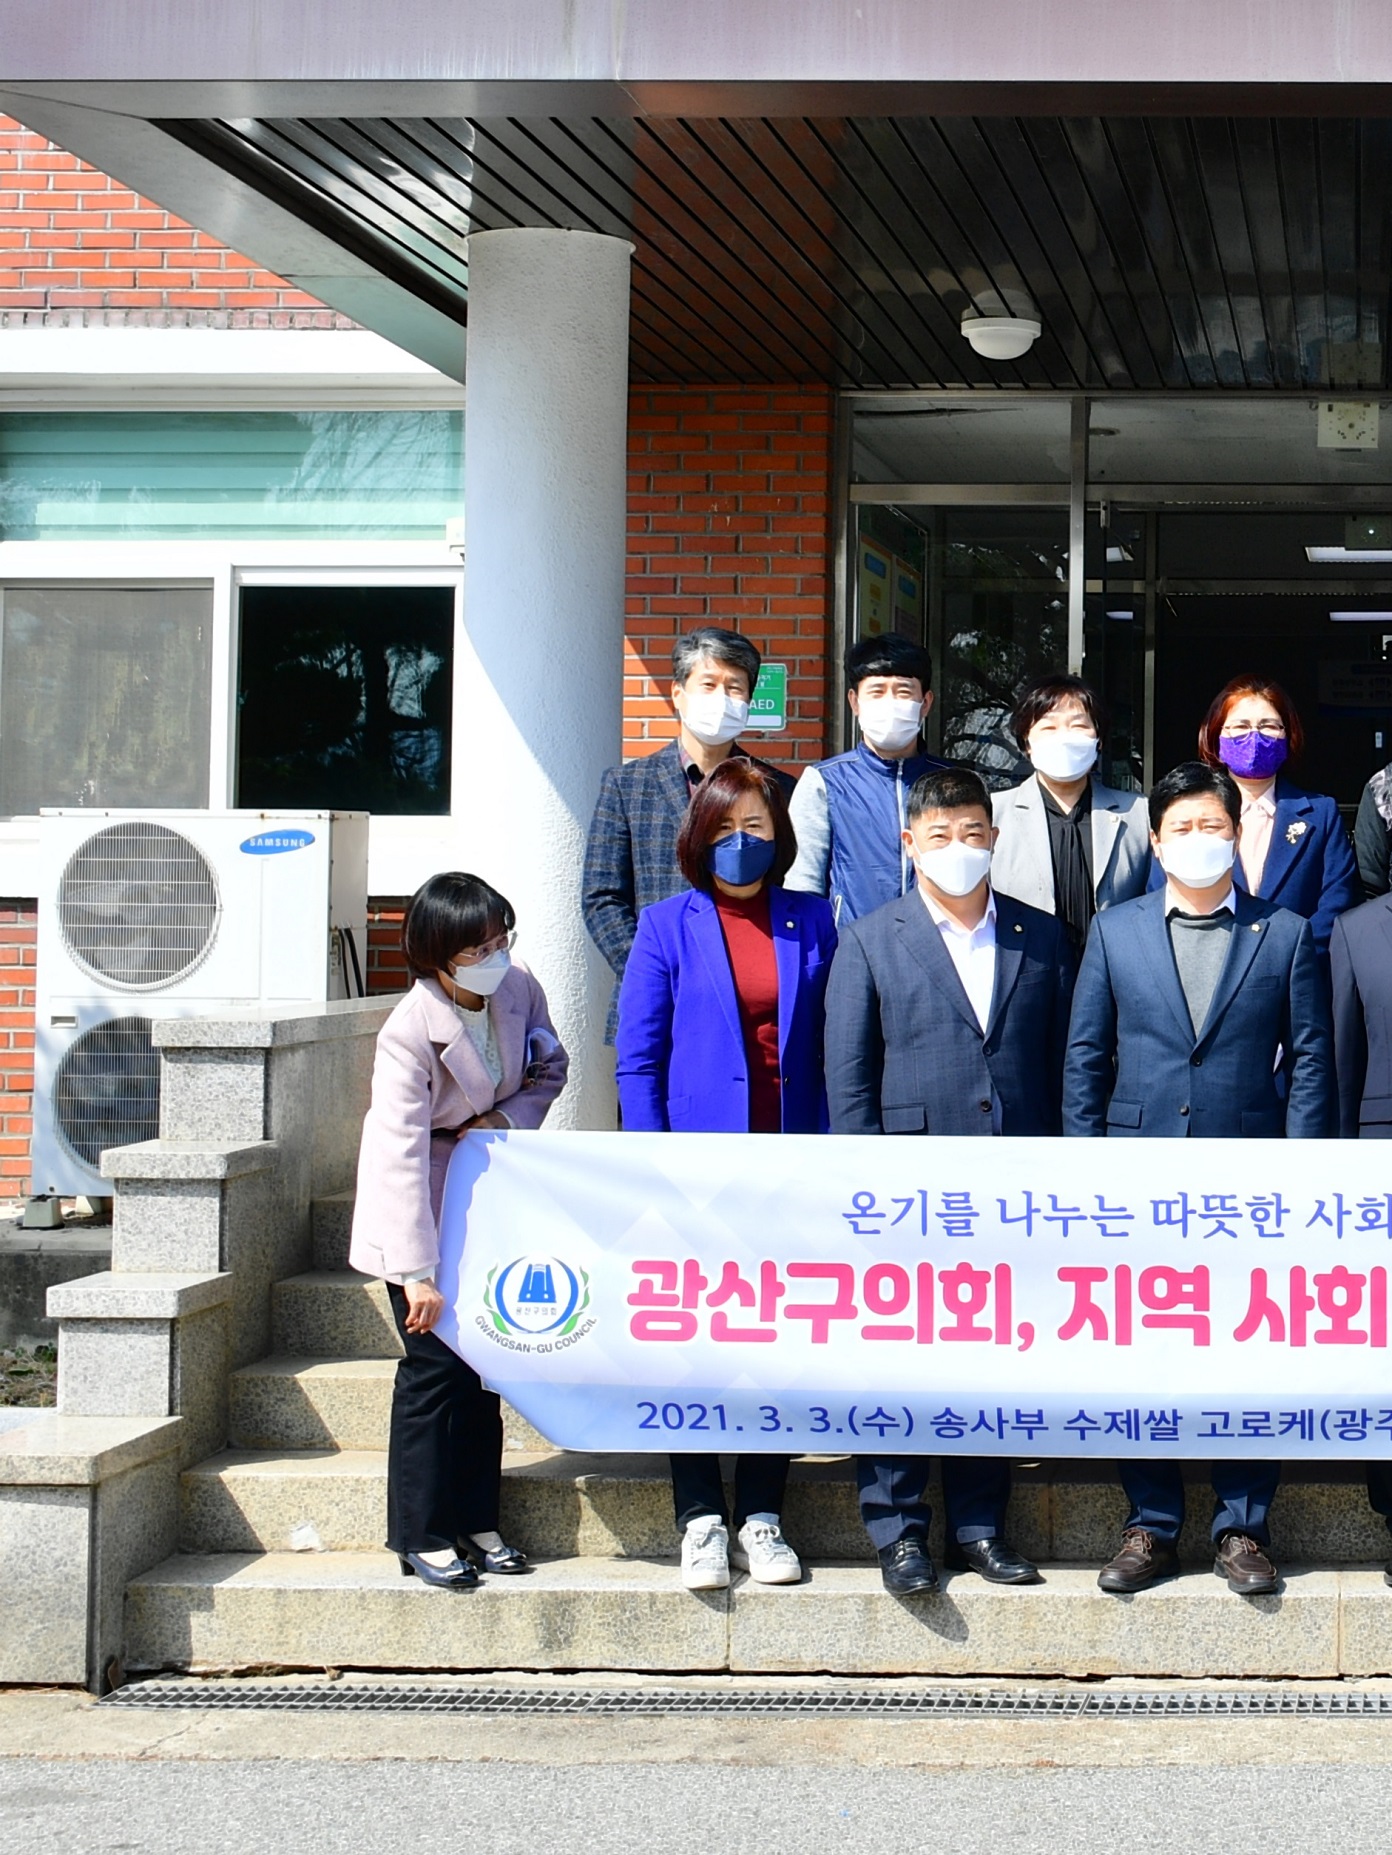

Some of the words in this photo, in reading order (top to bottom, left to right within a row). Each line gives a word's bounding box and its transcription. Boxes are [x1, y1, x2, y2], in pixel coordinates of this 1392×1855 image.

[749, 698, 775, 710] AED
[249, 837, 306, 848] SAMSUNG
[841, 1189, 980, 1237] 온기를
[996, 1190, 1135, 1238] 나누는
[1151, 1191, 1291, 1239] 따뜻한
[627, 1258, 1035, 1352] 광산구의회,
[1057, 1263, 1211, 1347] 지역
[1233, 1265, 1388, 1348] 사회
[475, 1315, 553, 1354] GWANGSAN-GU
[554, 1317, 598, 1350] COUNCIL
[635, 1401, 744, 1432] 2021.
[759, 1404, 795, 1433] 3.
[807, 1404, 915, 1438] 3.(수)
[929, 1405, 1050, 1441] 송사부
[1062, 1408, 1184, 1442] 수제쌀
